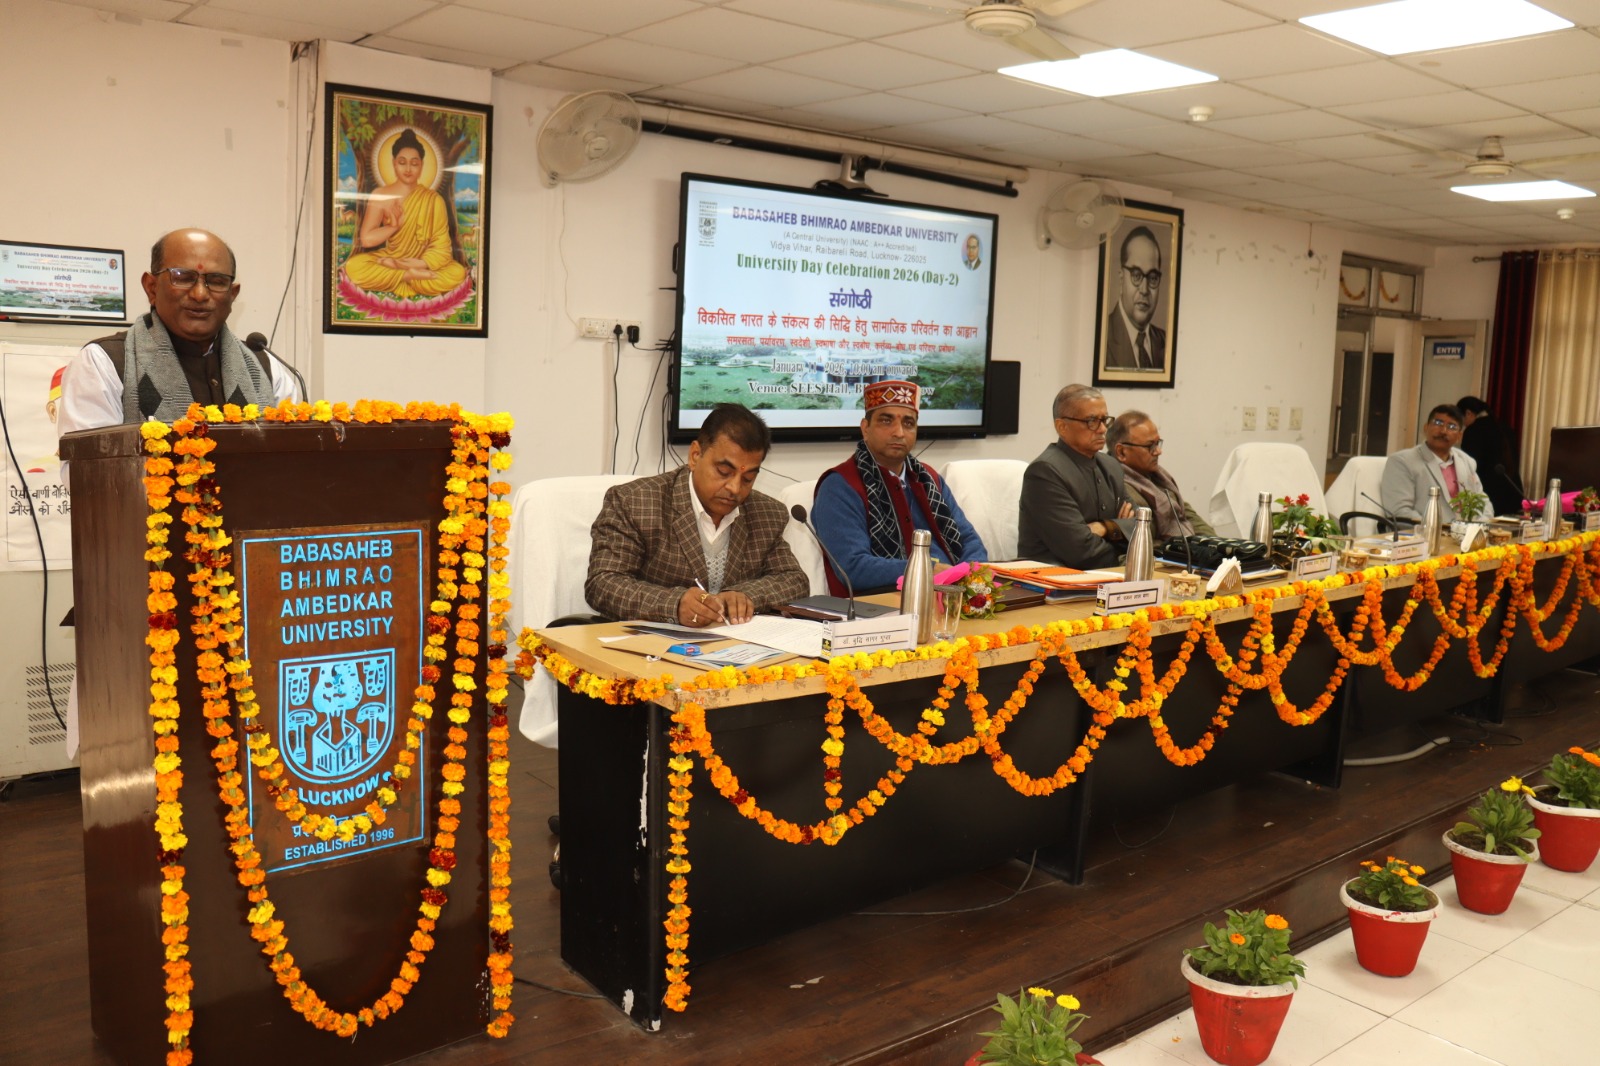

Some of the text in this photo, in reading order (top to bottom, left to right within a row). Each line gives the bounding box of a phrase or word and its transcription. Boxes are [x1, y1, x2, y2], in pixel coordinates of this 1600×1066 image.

[733, 206, 797, 225] BABASAHEB
[801, 214, 847, 230] BHIMRAO
[850, 220, 902, 236] AMBEDKAR
[905, 227, 958, 243] UNIVERSITY
[792, 232, 814, 241] Central
[816, 234, 848, 245] University)
[770, 241, 790, 251] Vidya
[793, 243, 812, 253] Vihar,
[815, 245, 847, 255] Raibareli
[904, 254, 926, 264] 226025
[737, 254, 959, 286] University Day Celebration 2026 (Day-2)
[829, 288, 872, 309] संगोष्ठी
[697, 307, 736, 326] विकसित
[741, 314, 763, 327] भारत
[768, 311, 777, 328] के
[782, 313, 809, 329] संकल्प
[814, 314, 825, 331] की
[829, 314, 851, 333] सिद्धि
[855, 316, 868, 336] हेतु
[871, 318, 907, 334] सामाजिक
[911, 319, 939, 336] परिवर्तन
[943, 325, 953, 337] का
[838, 338, 849, 349] और
[1436, 347, 1462, 355] ENTRY
[771, 358, 804, 375] January
[872, 366, 884, 375] am
[885, 363, 918, 376] onwards
[749, 382, 787, 393] Venue:
[825, 382, 851, 395] Hall,
[280, 539, 393, 564] BABASAHEB
[280, 565, 393, 590] BHIMRAO
[280, 590, 393, 618] AMBEDKAR
[281, 616, 394, 645] UNIVERSITY
[298, 773, 380, 806] LUCKNOW
[285, 828, 395, 860] ESTABLISHED 1996
